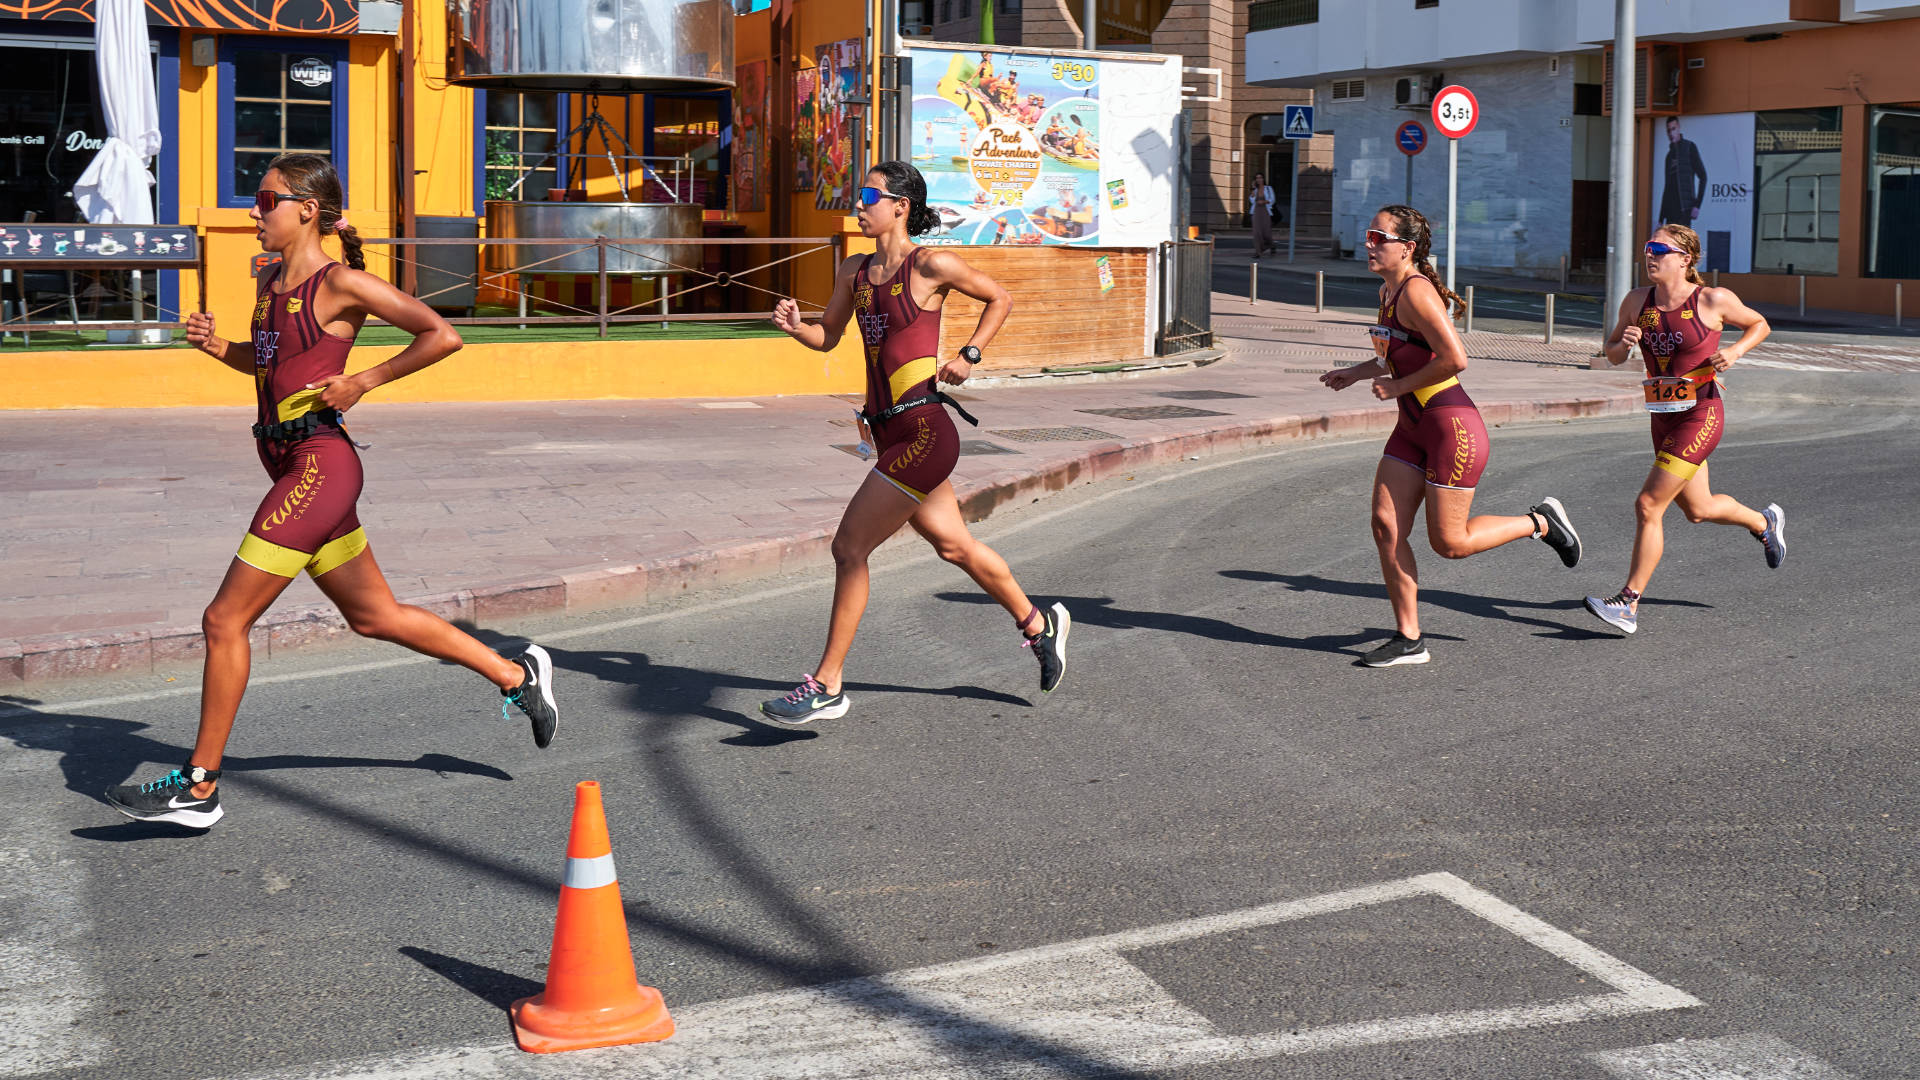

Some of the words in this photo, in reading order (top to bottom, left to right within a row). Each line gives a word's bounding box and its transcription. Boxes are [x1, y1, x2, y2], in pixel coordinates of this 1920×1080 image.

[23, 136, 45, 144] Grill
[66, 130, 104, 151] Don
[989, 128, 1022, 143] Pack
[972, 141, 1041, 158] Adventure
[1712, 183, 1746, 198] BOSS
[866, 329, 884, 344] ESP
[1643, 331, 1683, 345] SOCAS
[256, 347, 274, 365] ESP
[1651, 343, 1675, 355] ESP
[261, 454, 320, 531] Wilier
[293, 474, 326, 520] CANARIAS
